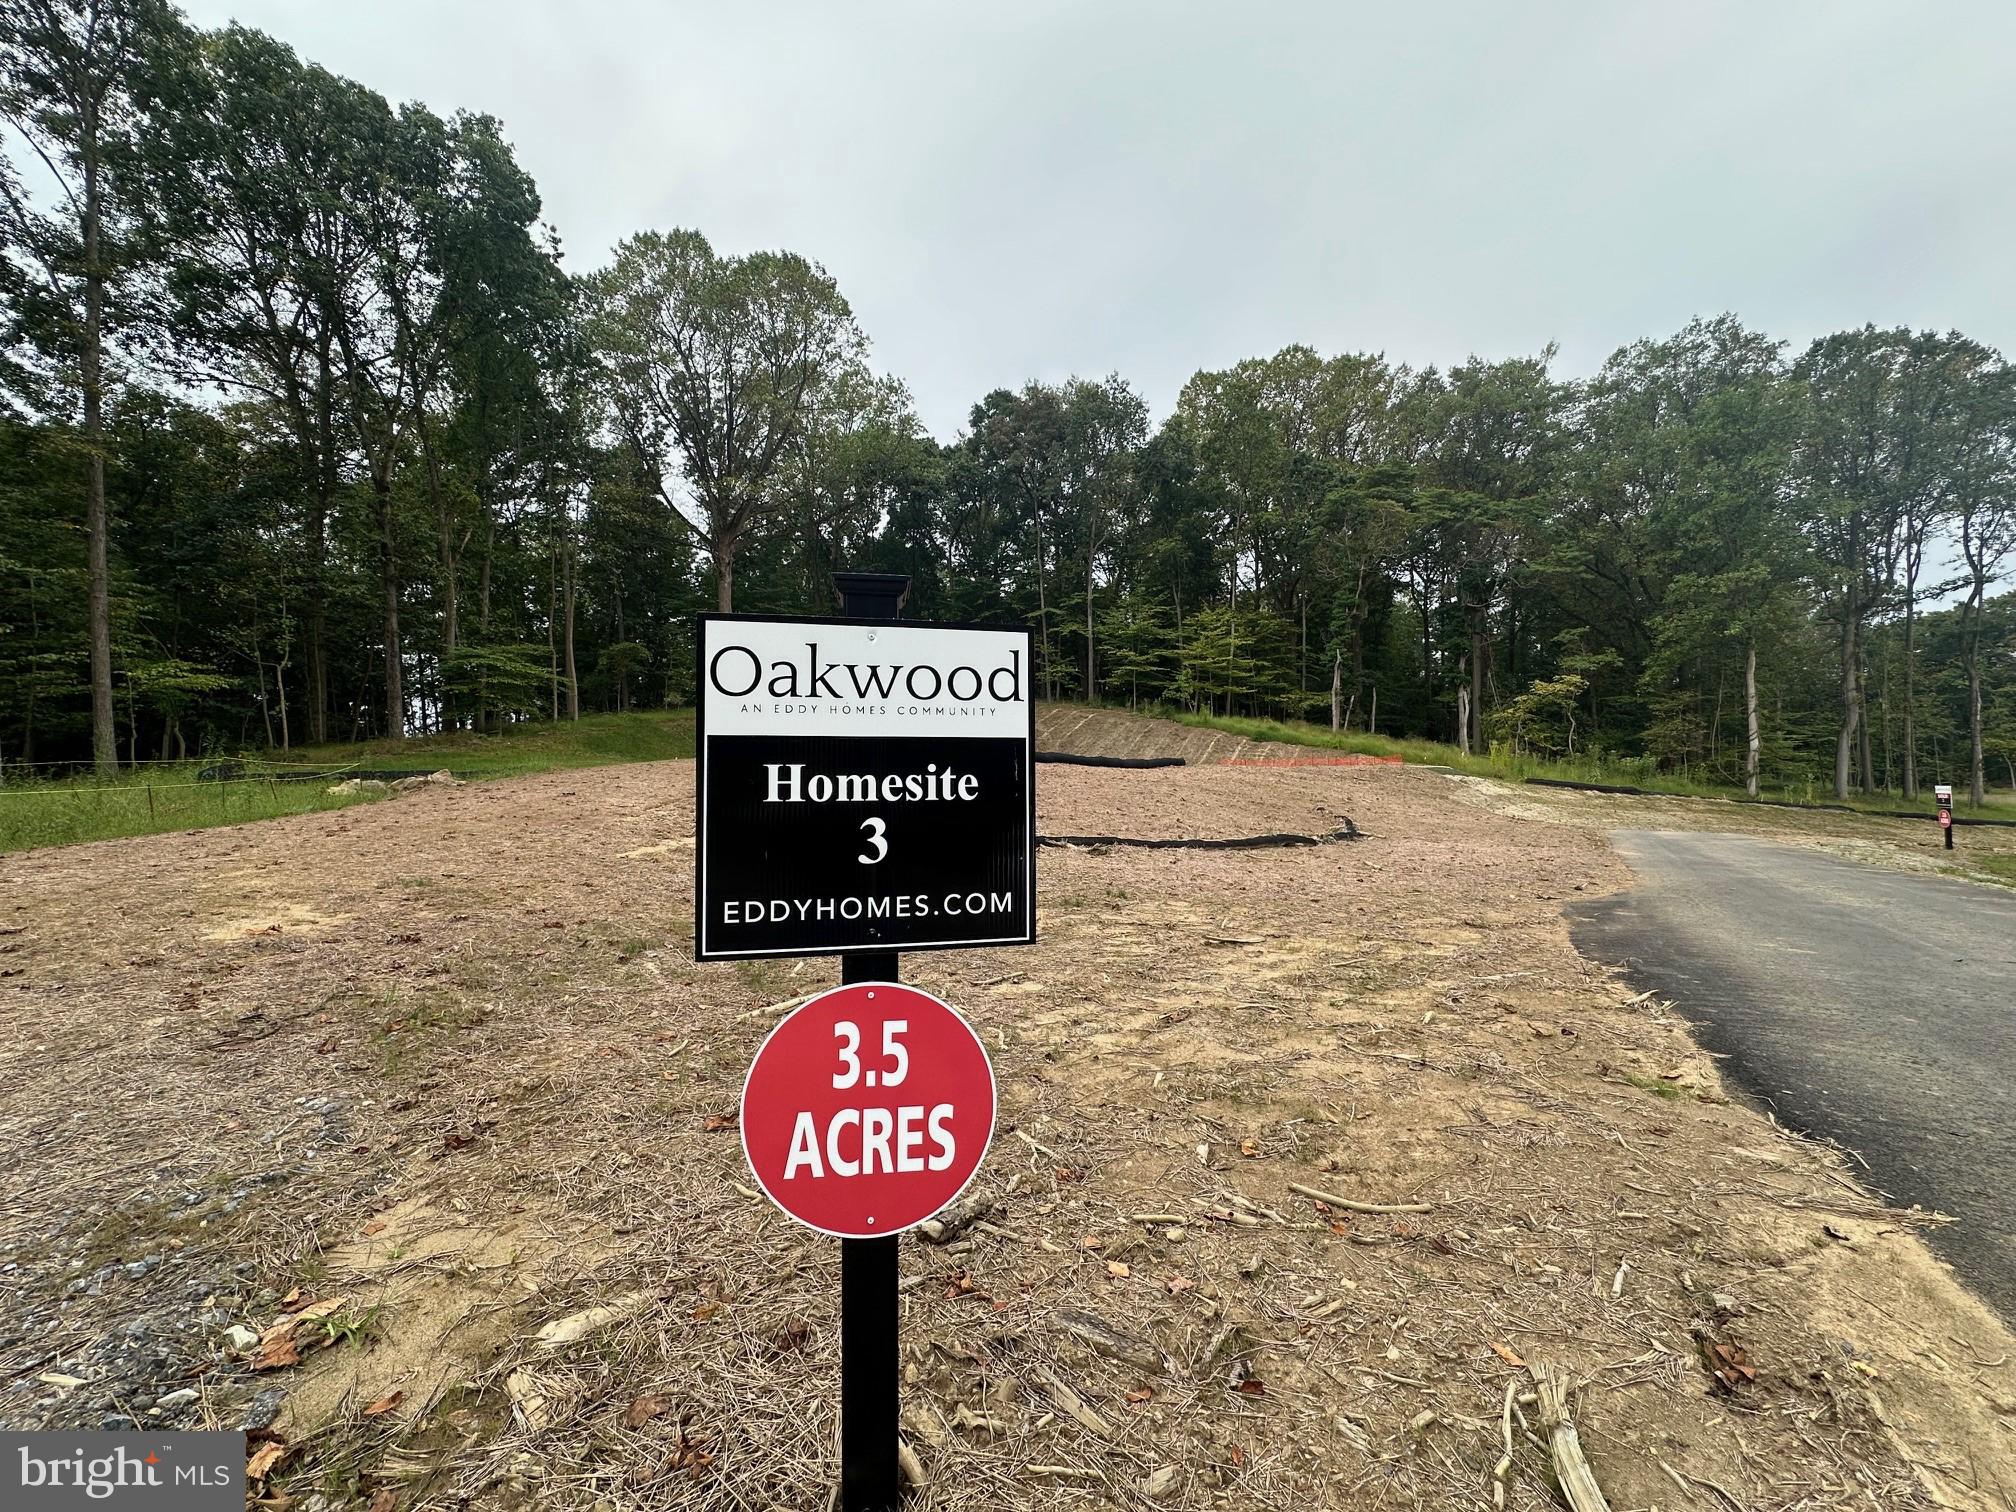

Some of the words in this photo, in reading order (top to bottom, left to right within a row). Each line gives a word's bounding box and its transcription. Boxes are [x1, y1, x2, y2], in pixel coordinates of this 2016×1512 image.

[710, 643, 1024, 702] Oakwood
[741, 704, 762, 713] AN
[774, 704, 818, 714] EDDY
[829, 705, 887, 715] HOMES
[897, 706, 996, 716] COMMUNITY
[763, 763, 979, 802] Homesite
[857, 817, 888, 864] 3
[723, 892, 1012, 924] EDDYHOMES.COM
[832, 1019, 909, 1090] 3.5
[783, 1103, 956, 1180] ACRES
